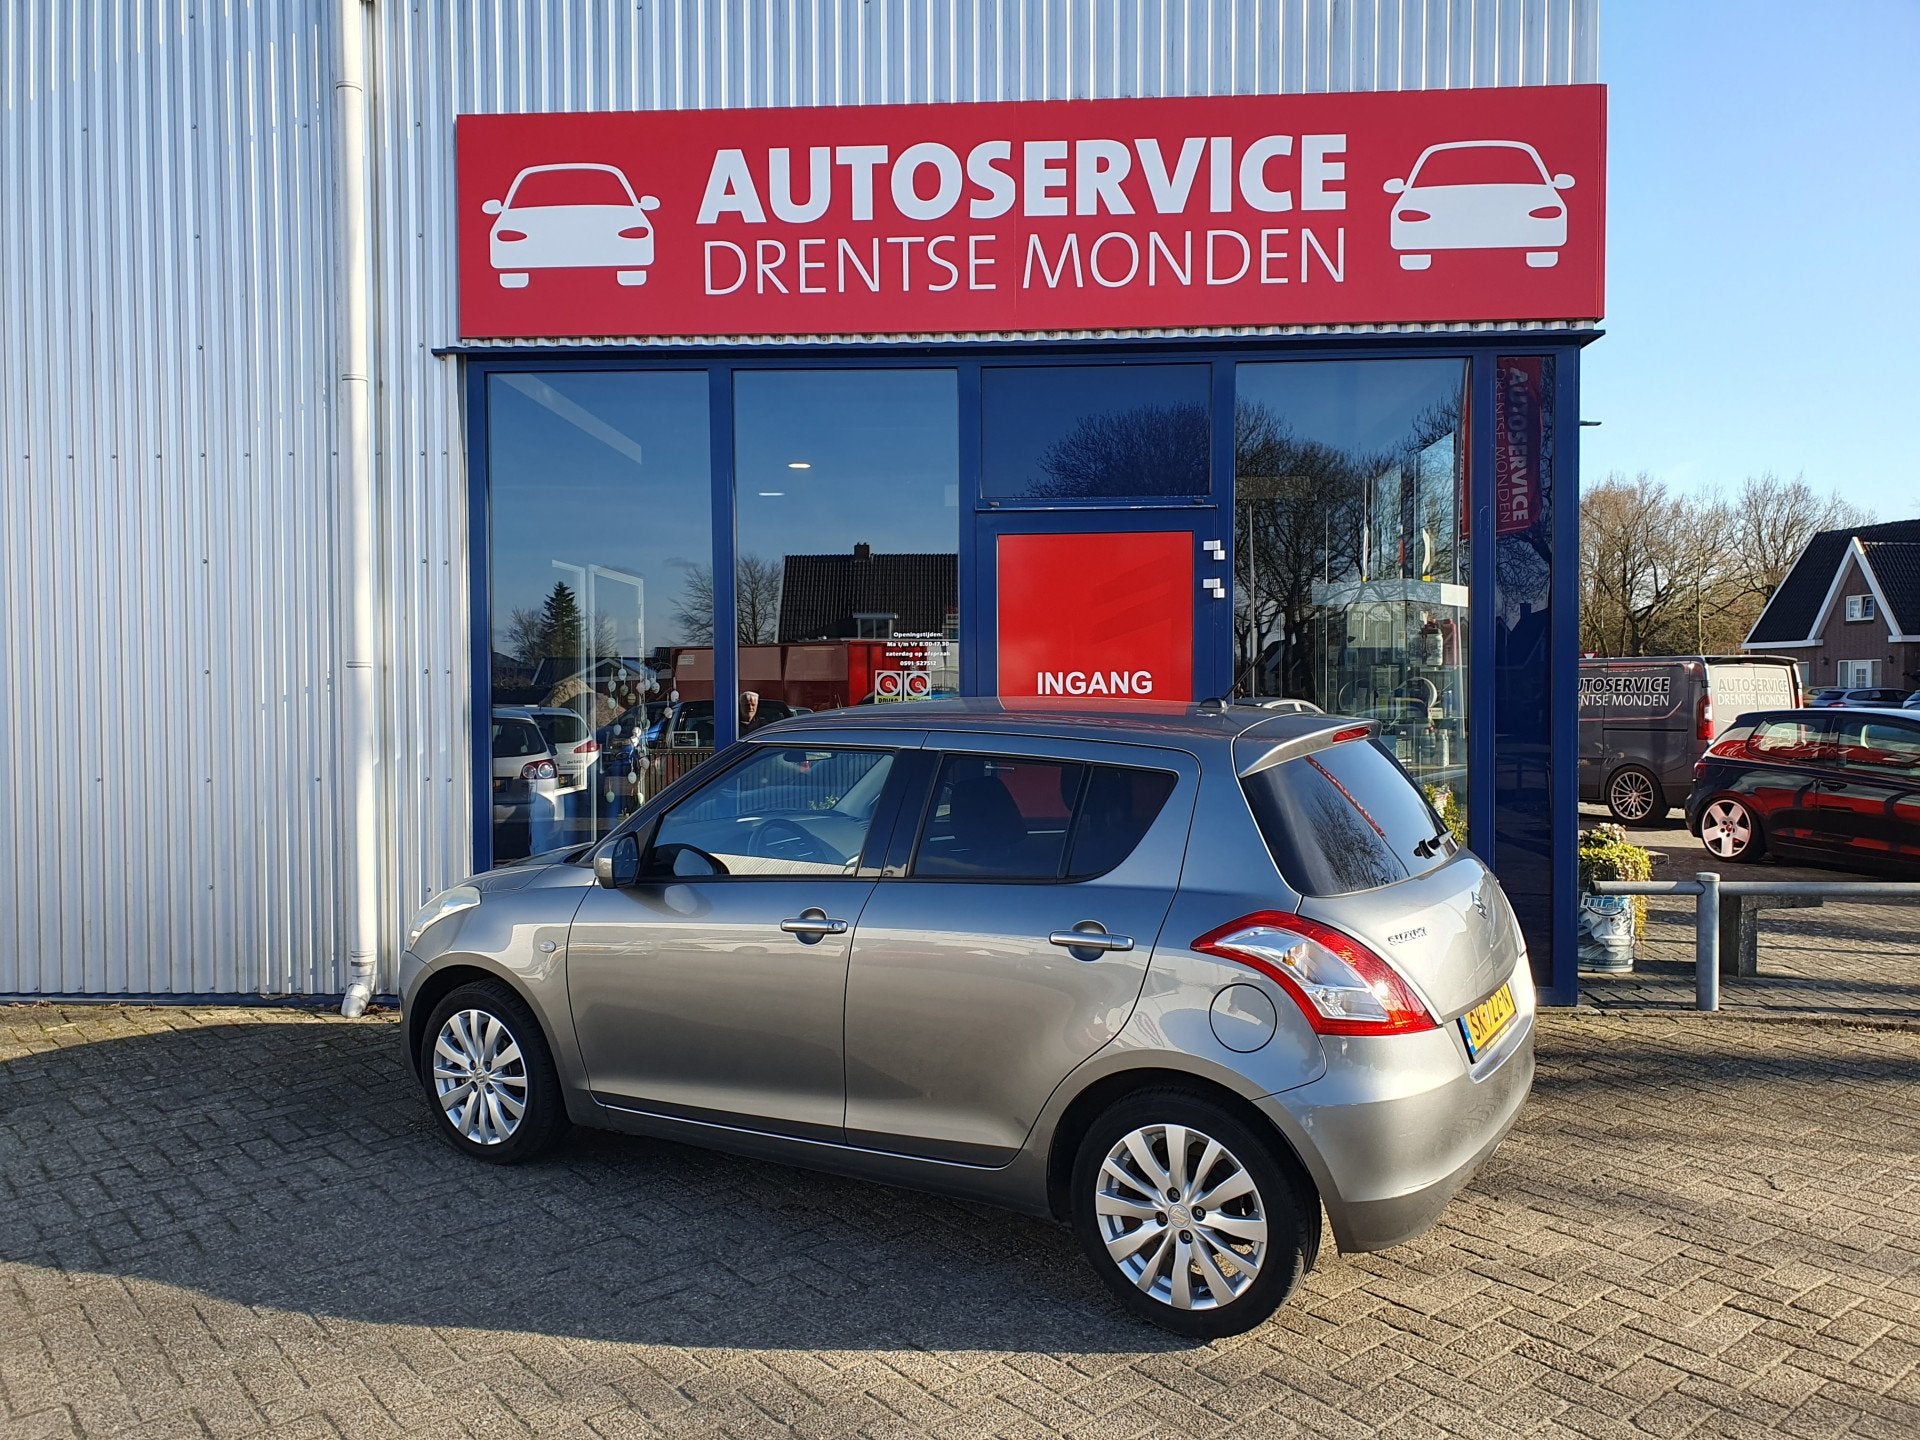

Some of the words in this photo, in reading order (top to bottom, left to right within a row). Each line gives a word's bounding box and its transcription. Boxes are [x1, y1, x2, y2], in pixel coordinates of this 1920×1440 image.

[696, 133, 1347, 225] AUTOSERVICE
[703, 234, 997, 296] DRENTSE
[1022, 227, 1346, 290] MONDEN
[1507, 367, 1529, 522] AUTOSERVICE
[1037, 671, 1153, 695] INGANG
[1579, 676, 1671, 693] TOSERVICE
[1717, 677, 1789, 693] AUTOSERVICE
[1579, 694, 1609, 706] NTSE
[1611, 693, 1670, 706] MONDEN
[1717, 693, 1756, 706] DRENTSE
[1757, 693, 1790, 706] MONDEN
